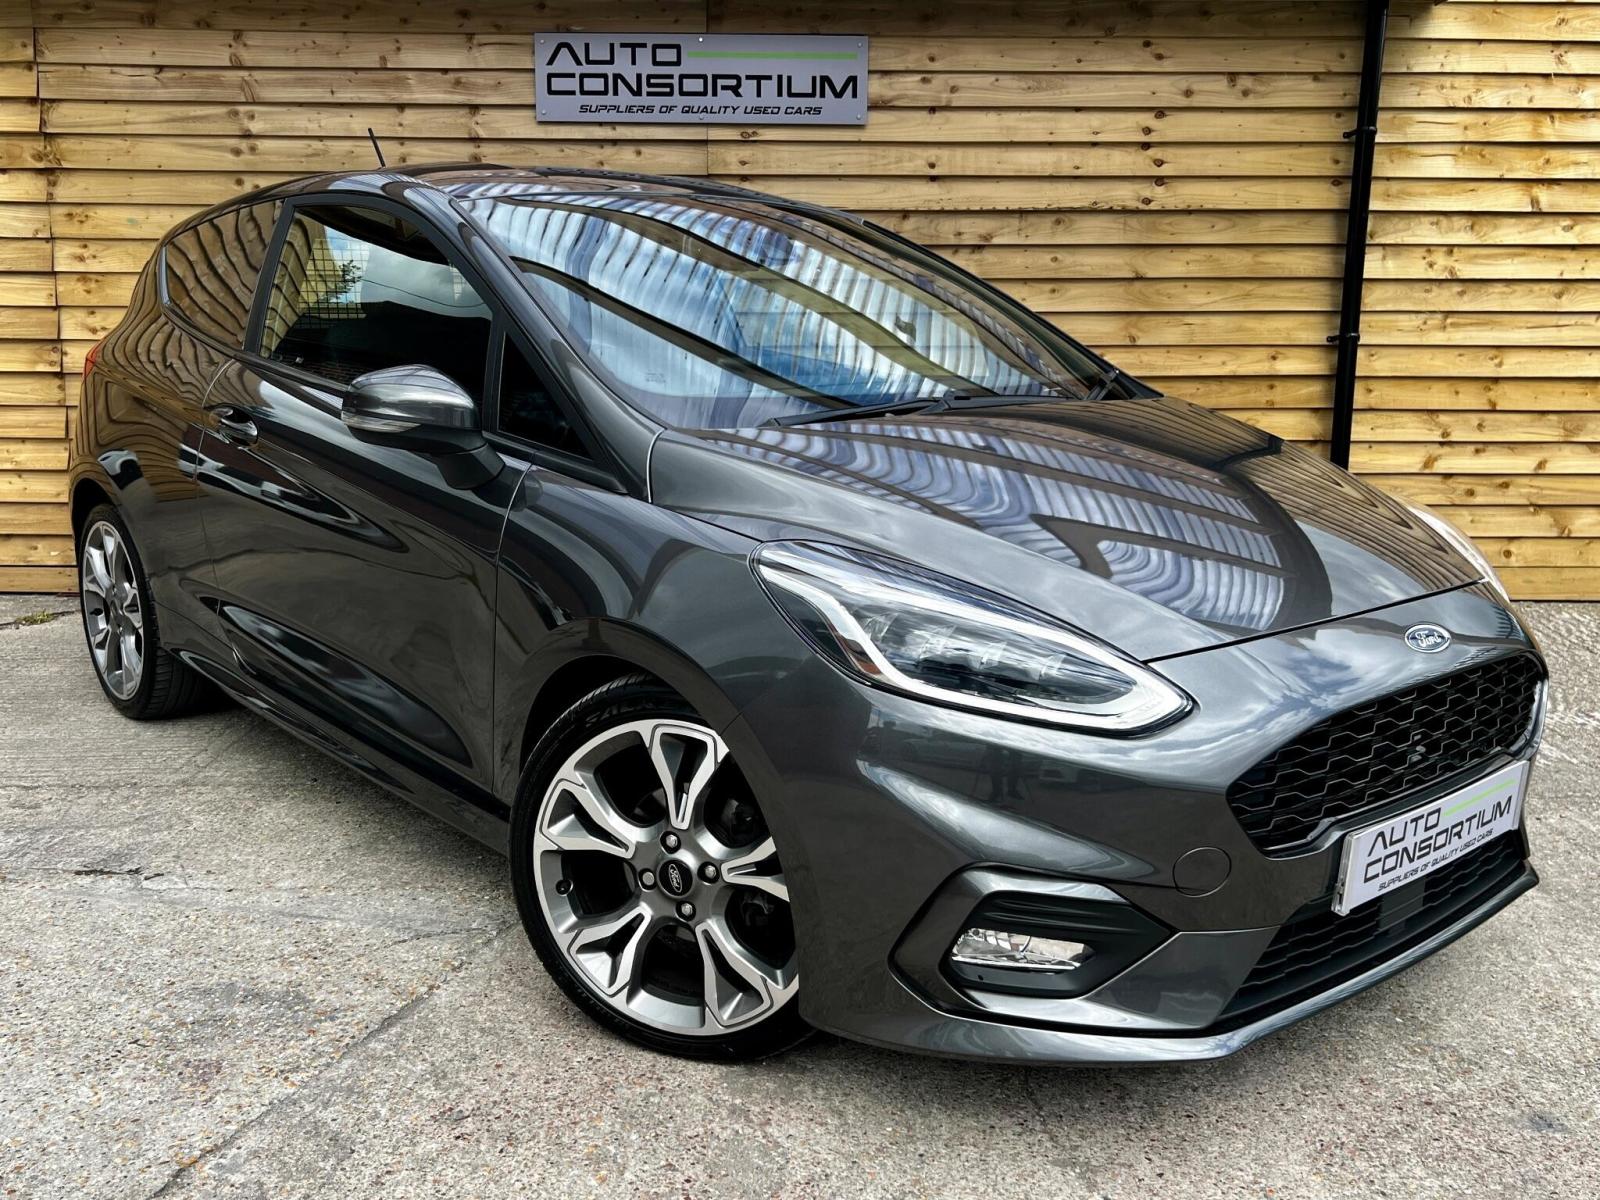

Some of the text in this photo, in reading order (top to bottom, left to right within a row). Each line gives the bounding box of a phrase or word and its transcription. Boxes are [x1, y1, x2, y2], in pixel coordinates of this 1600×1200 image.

[546, 42, 682, 67] AUTO
[546, 72, 858, 99] CONSORTIUM
[578, 104, 823, 116] SUPPLIERS OF QUALITY USED CARS
[1414, 630, 1442, 648] Ford
[1363, 794, 1513, 884] CONSORTIUM
[1367, 807, 1442, 857] AUTO
[1377, 868, 1419, 892] SUPPLIERS
[1419, 861, 1431, 874] OF
[1430, 849, 1460, 867] QUALITY
[1476, 828, 1494, 844] CARS
